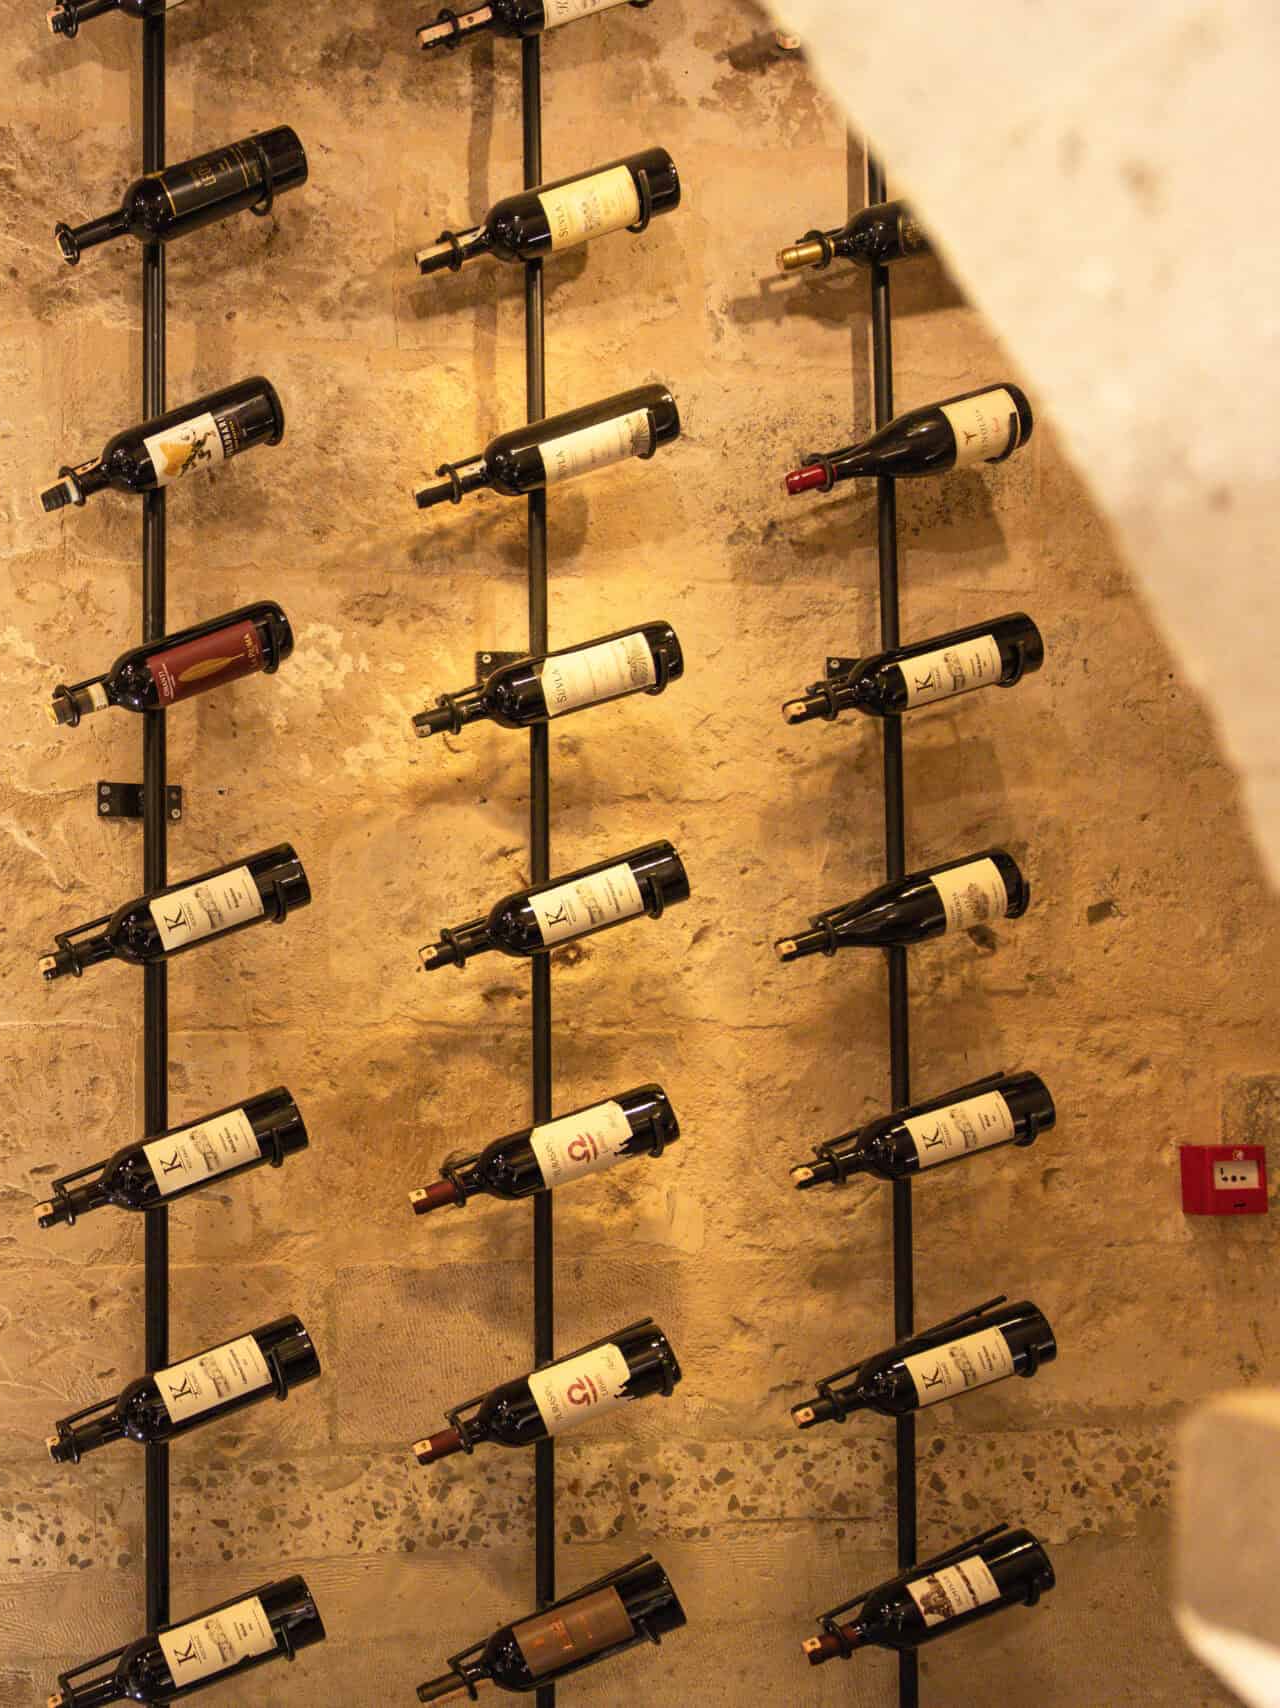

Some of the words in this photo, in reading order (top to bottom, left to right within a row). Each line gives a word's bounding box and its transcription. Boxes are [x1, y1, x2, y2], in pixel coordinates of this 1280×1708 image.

[914, 672, 933, 693] K
[164, 909, 187, 932] K
[545, 904, 568, 928] K
[922, 1127, 945, 1151] K
[159, 1151, 183, 1175] K
[168, 1377, 192, 1400] K
[921, 1367, 944, 1390] K
[174, 1640, 197, 1665] K
